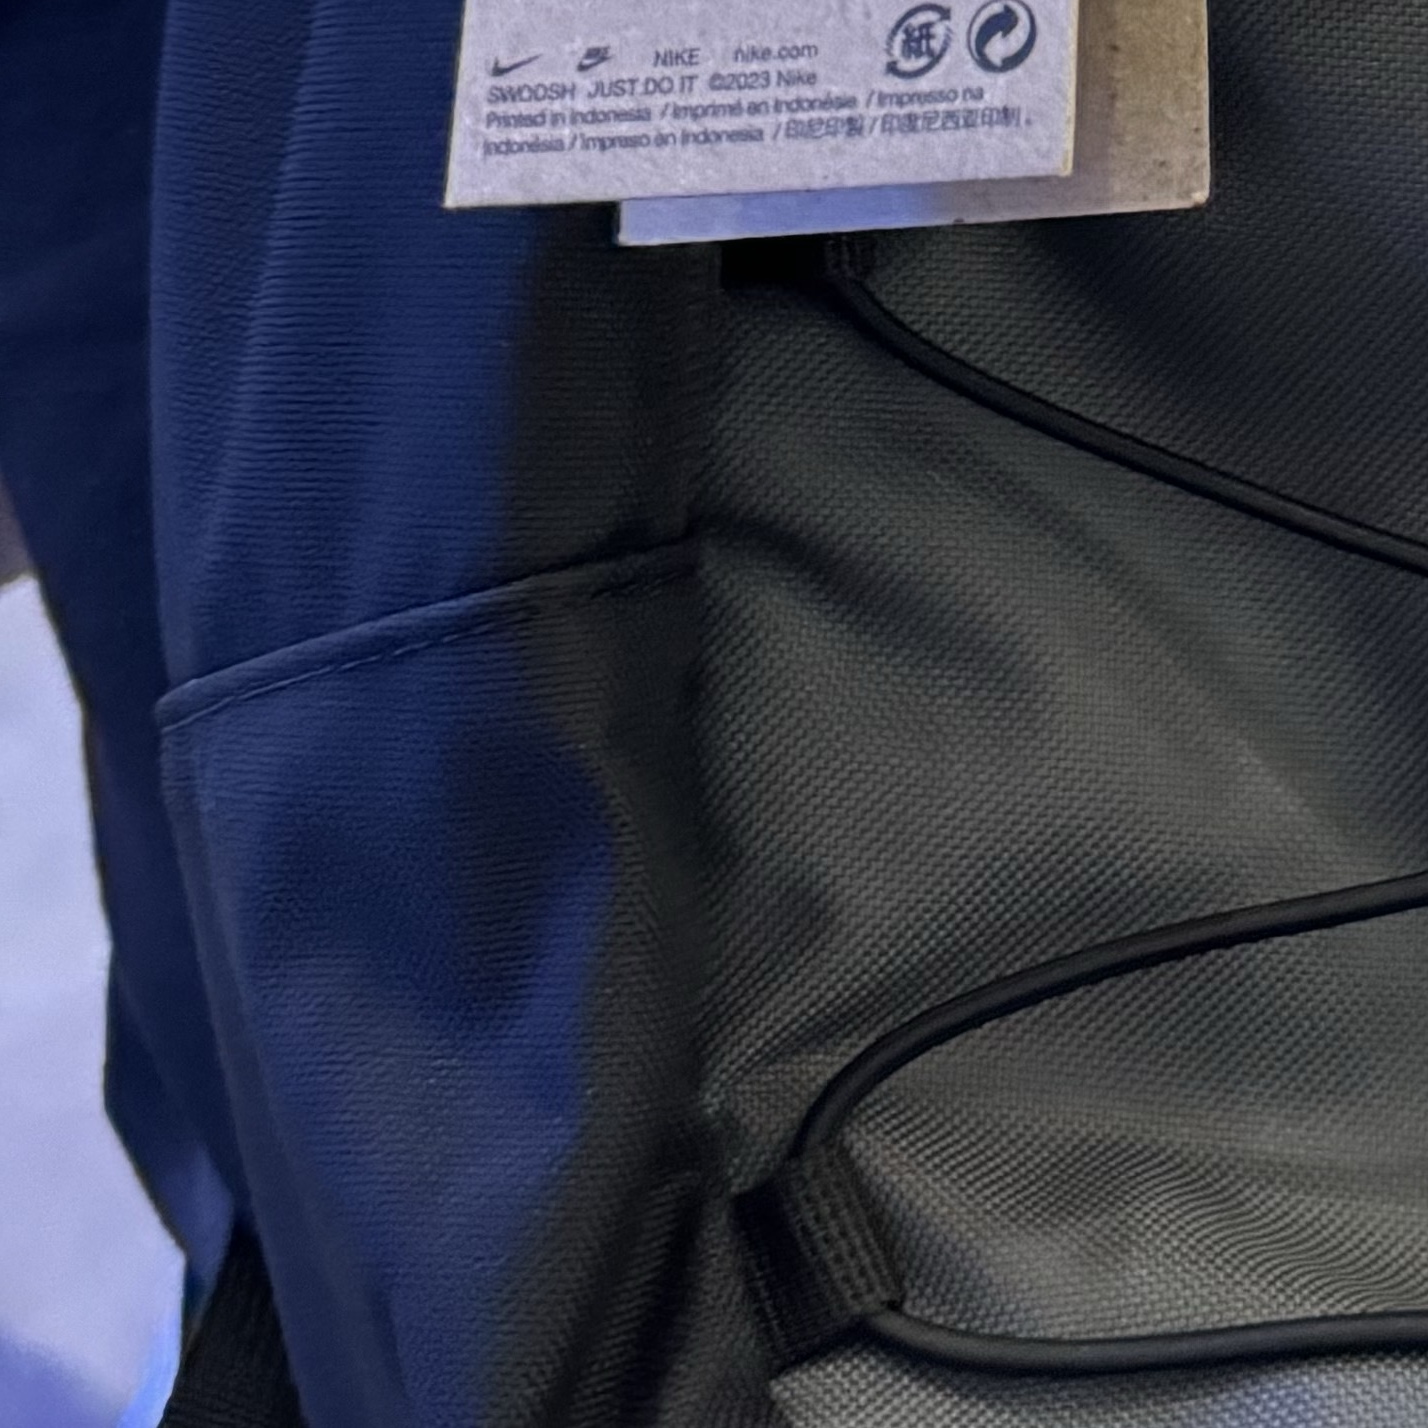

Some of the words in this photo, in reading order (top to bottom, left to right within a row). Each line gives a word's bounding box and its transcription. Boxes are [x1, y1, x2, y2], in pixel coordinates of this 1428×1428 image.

[652, 47, 701, 69] NIKE
[732, 43, 818, 64] nike.com
[486, 81, 576, 105] SWOOSH
[587, 77, 640, 100] JUST
[645, 75, 675, 95] DO
[679, 74, 700, 94] IT
[776, 69, 817, 87] Nike
[486, 109, 547, 129] Printed
[550, 107, 566, 126] in
